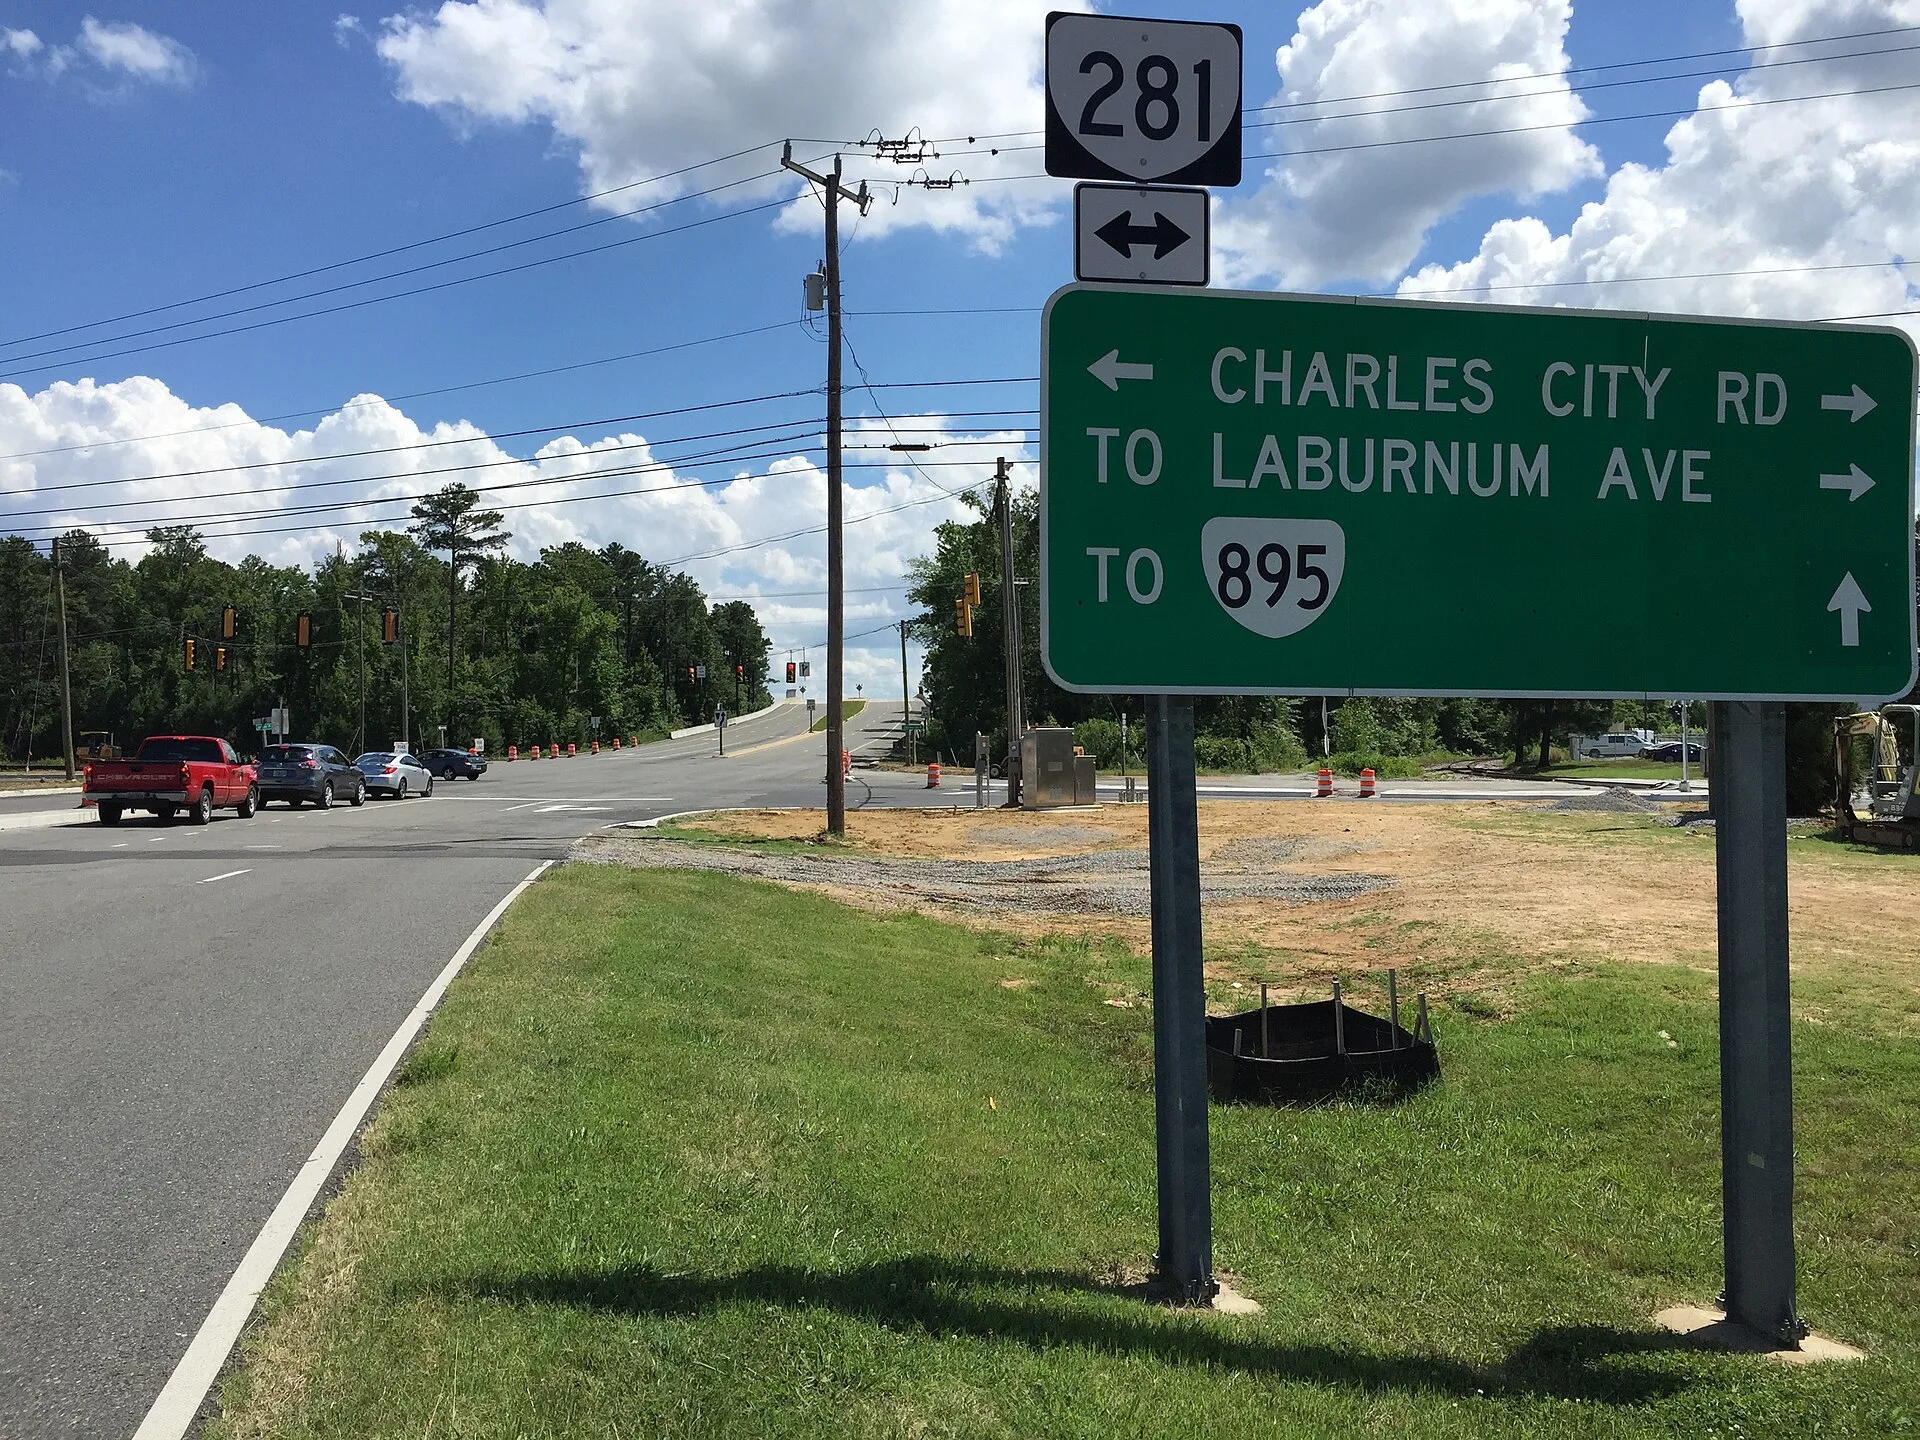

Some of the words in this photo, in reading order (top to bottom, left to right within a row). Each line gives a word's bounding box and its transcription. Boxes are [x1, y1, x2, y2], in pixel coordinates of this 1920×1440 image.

[1079, 51, 1212, 143] 281
[1211, 347, 1494, 414] CHARLES
[1542, 362, 1670, 419] CITY
[1718, 371, 1788, 425] RD
[1087, 428, 1163, 485] TO
[1213, 433, 1549, 497] LABURNUM
[1598, 447, 1712, 503] AVE
[1087, 548, 1164, 604] TO
[1217, 543, 1330, 612] 895
